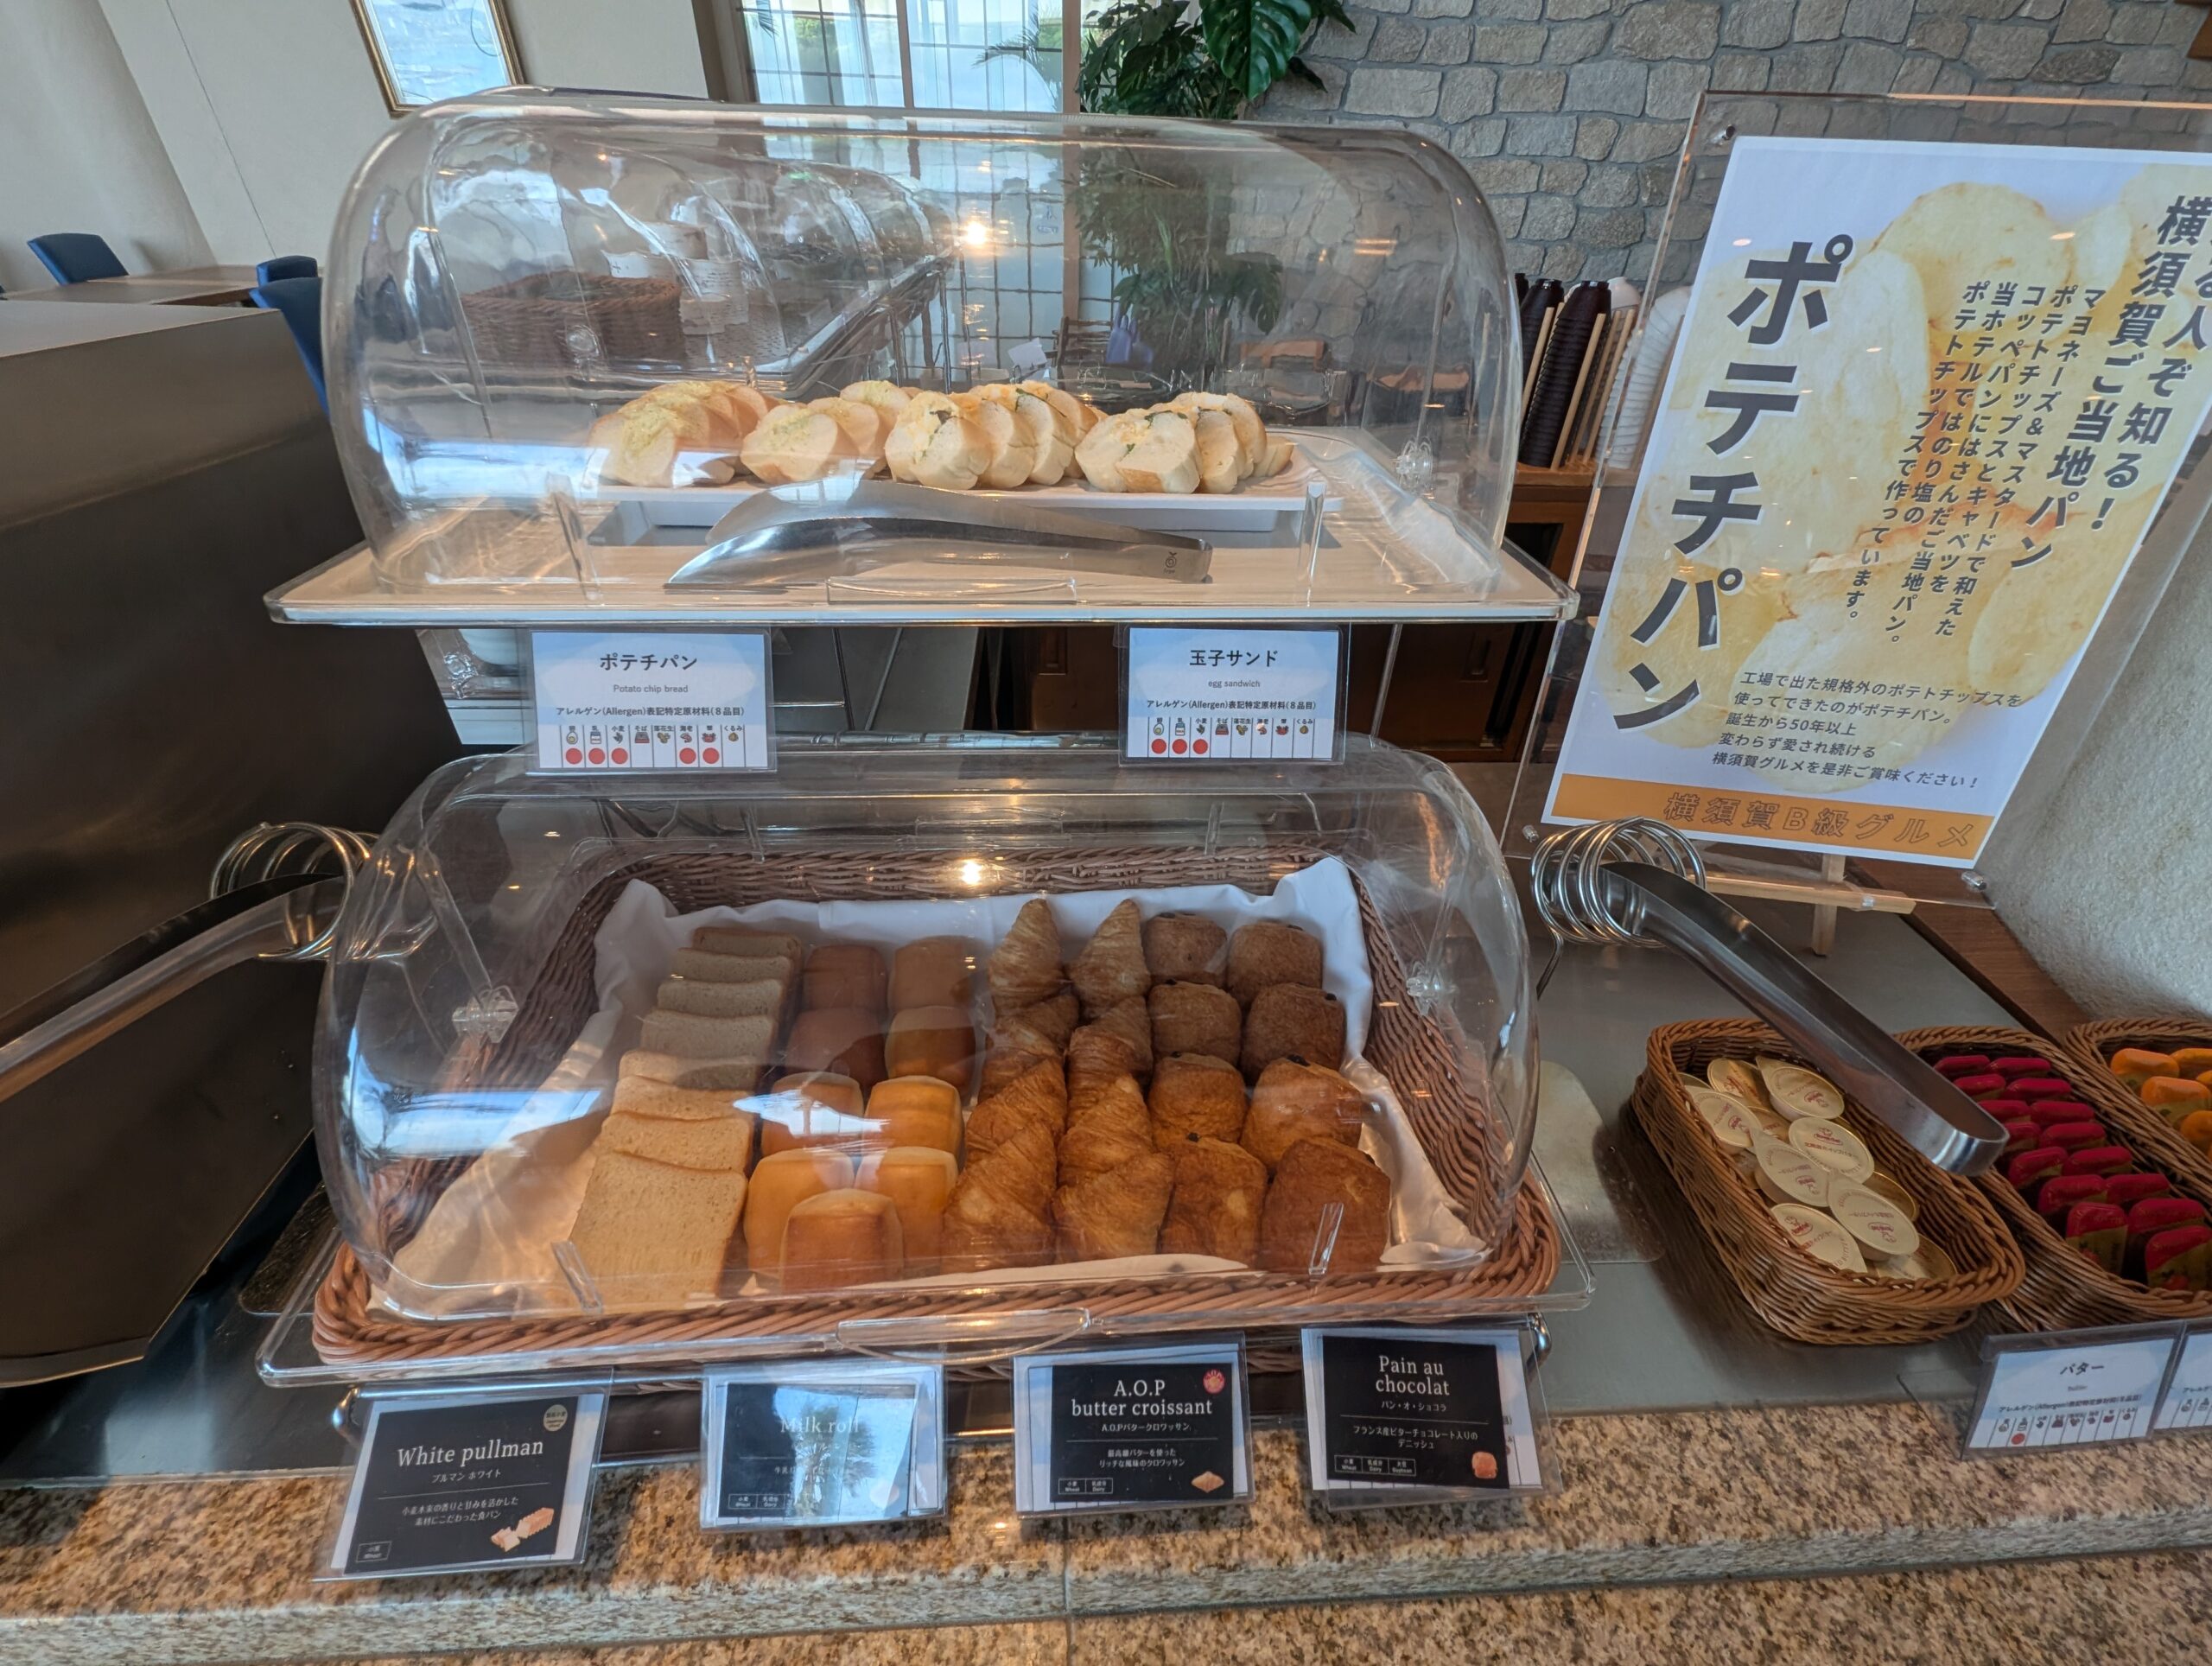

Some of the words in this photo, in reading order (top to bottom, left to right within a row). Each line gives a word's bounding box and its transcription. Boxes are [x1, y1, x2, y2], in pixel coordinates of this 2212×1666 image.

[2011, 195, 2212, 569] 横須賀ご当地パン
[1904, 281, 2018, 525] 当ホテルではのり塩の
[1846, 280, 1991, 619] ポテトチップスで作っています。
[1929, 284, 2078, 594] ポテトチップスとキャベツを
[1885, 286, 2047, 643] コッペパンにはさんだご当地パン。
[1612, 233, 1854, 731] ポテチパン
[599, 653, 697, 671] ポテチパン
[1189, 649, 1279, 668] 玉子サンド
[613, 684, 642, 694] Potato
[644, 684, 662, 695] chip
[664, 684, 689, 694] bread
[1208, 679, 1222, 689] egg
[1224, 679, 1261, 688] sandwich
[1740, 671, 2023, 708] 工場で出た規格外のポテトチップスを
[1733, 691, 1951, 724] 使ってできたのがポテチパン。
[1726, 712, 1857, 736] 誕生から50年以上
[1718, 732, 1877, 760] 変わらず愛され続ける
[1712, 751, 1979, 789] 横須賀グルメを是非ご賞味ください！
[1663, 792, 1974, 849] 横須賀B級グルメ
[1378, 1355, 1418, 1374] Pain
[1423, 1363, 1444, 1376] au
[2060, 1361, 2105, 1376] バター
[1114, 1379, 1166, 1397] A.O.P
[1376, 1375, 1450, 1396] chocolat
[1071, 1398, 1126, 1417] butter
[1132, 1399, 1213, 1415] croissant
[1381, 1400, 1447, 1413] パン・オ・ショコラ
[780, 1415, 822, 1433] Milk
[828, 1415, 859, 1433] roll
[397, 1446, 454, 1467] White
[461, 1438, 544, 1467] pullman
[1397, 1439, 1435, 1450] デニッシュ
[468, 1469, 501, 1480] ホワイト
